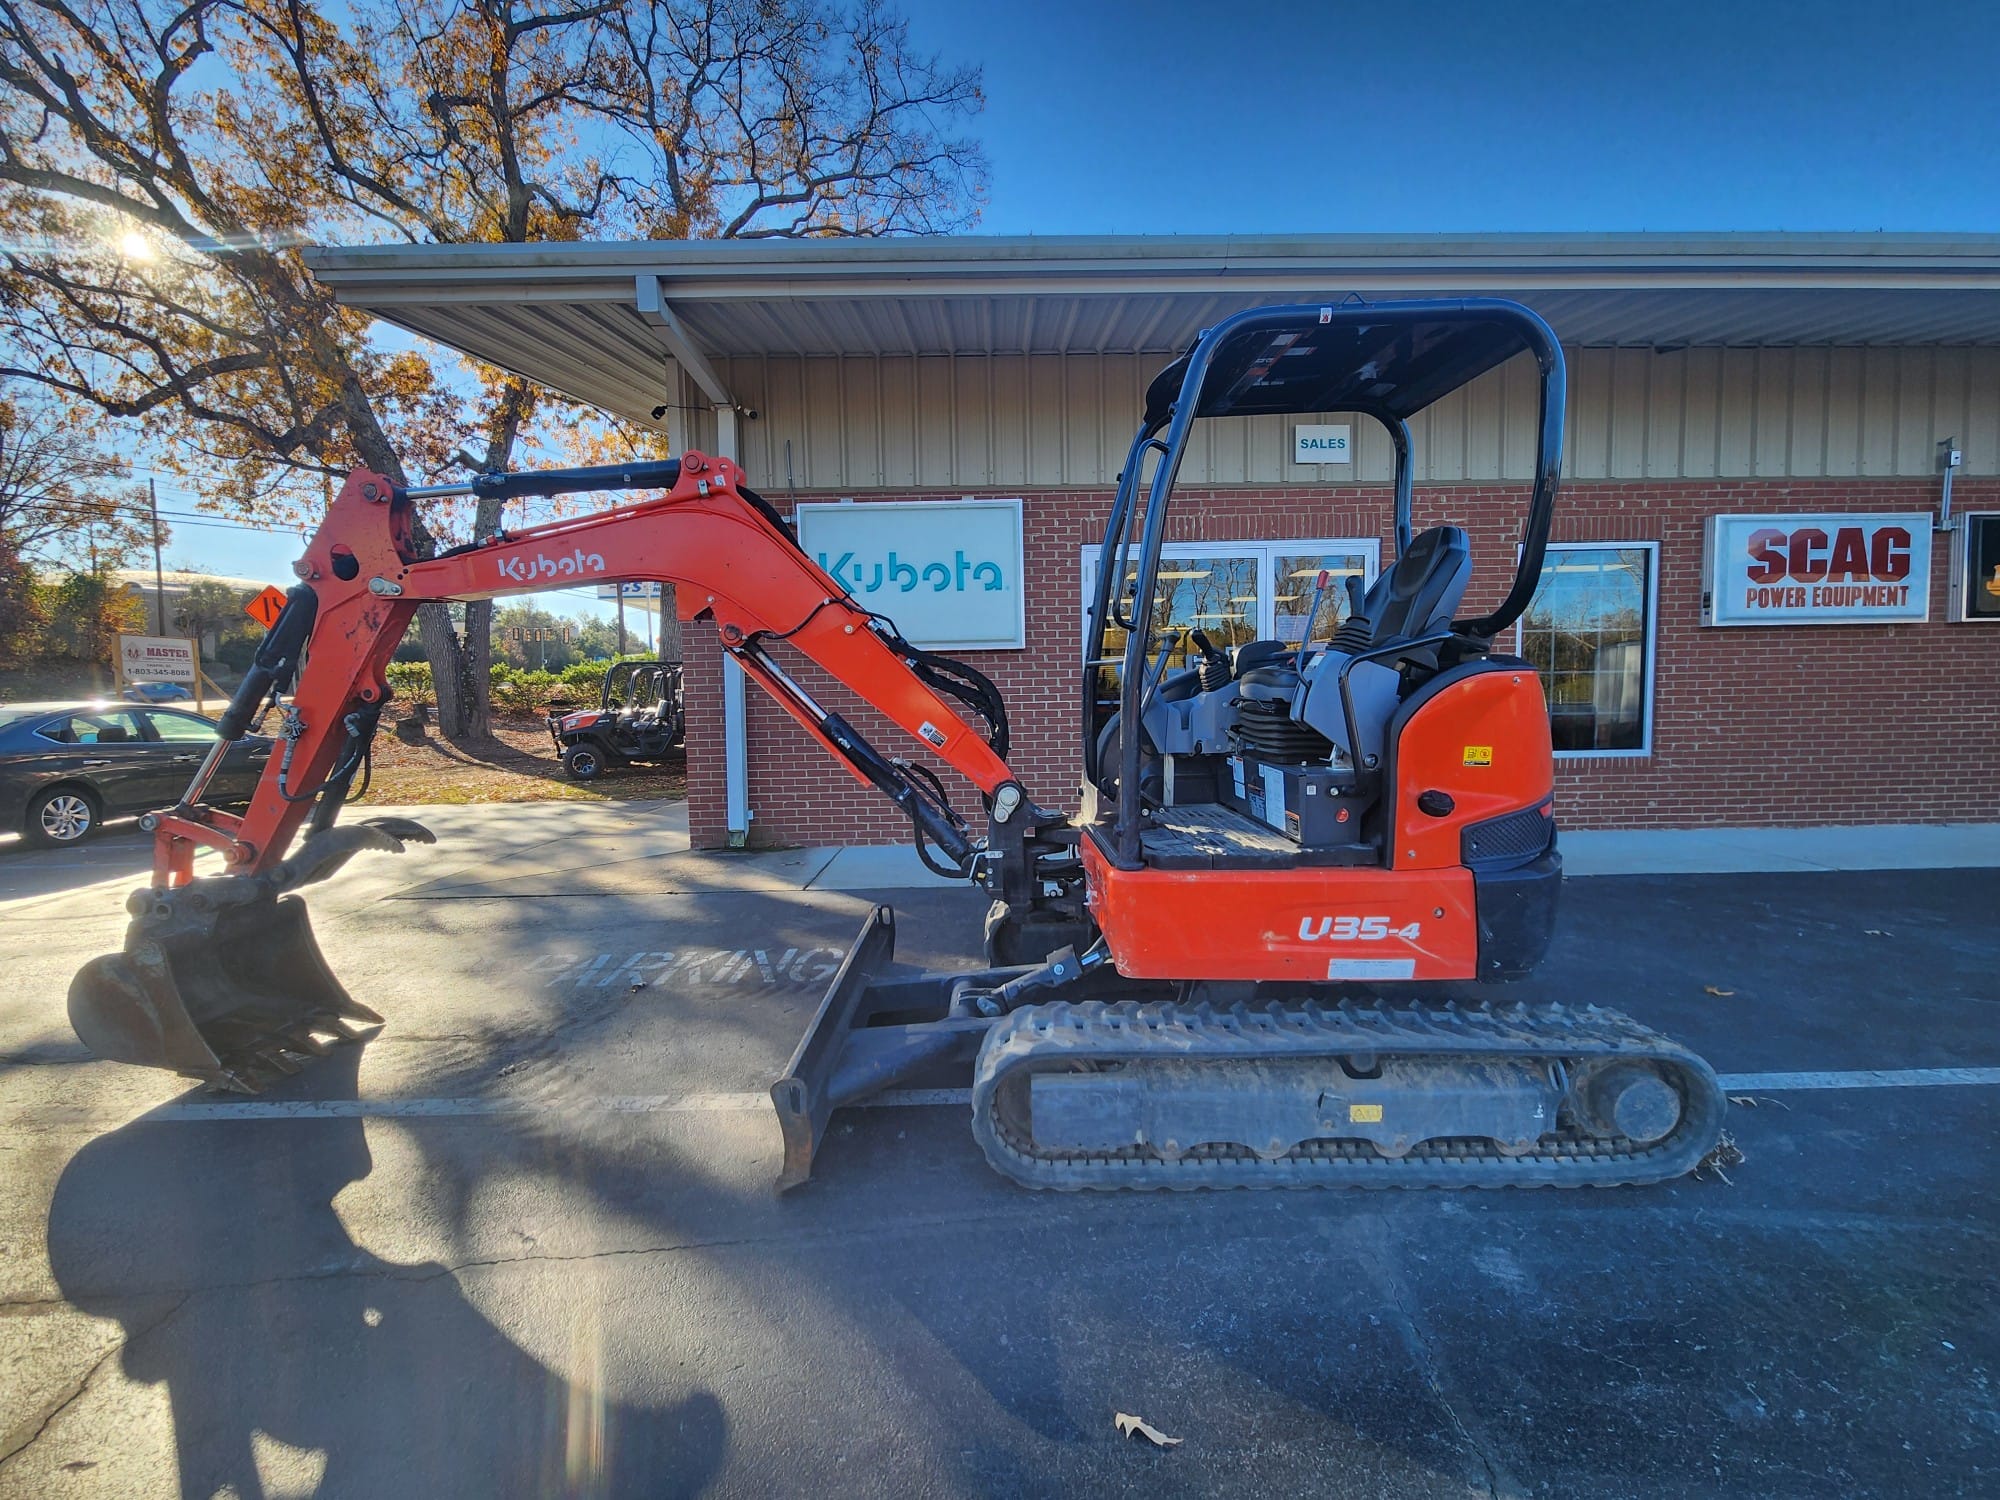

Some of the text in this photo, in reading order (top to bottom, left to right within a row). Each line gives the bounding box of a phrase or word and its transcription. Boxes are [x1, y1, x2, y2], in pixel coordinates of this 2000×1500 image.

[1300, 438, 1346, 449] SALES
[498, 549, 605, 581] Kubota
[1747, 527, 1911, 584] SCAG
[819, 551, 1003, 594] Kubota
[1746, 585, 1909, 608] POWER EQUIPMENT
[146, 647, 189, 658] MASTER
[1299, 916, 1421, 941] U35-4
